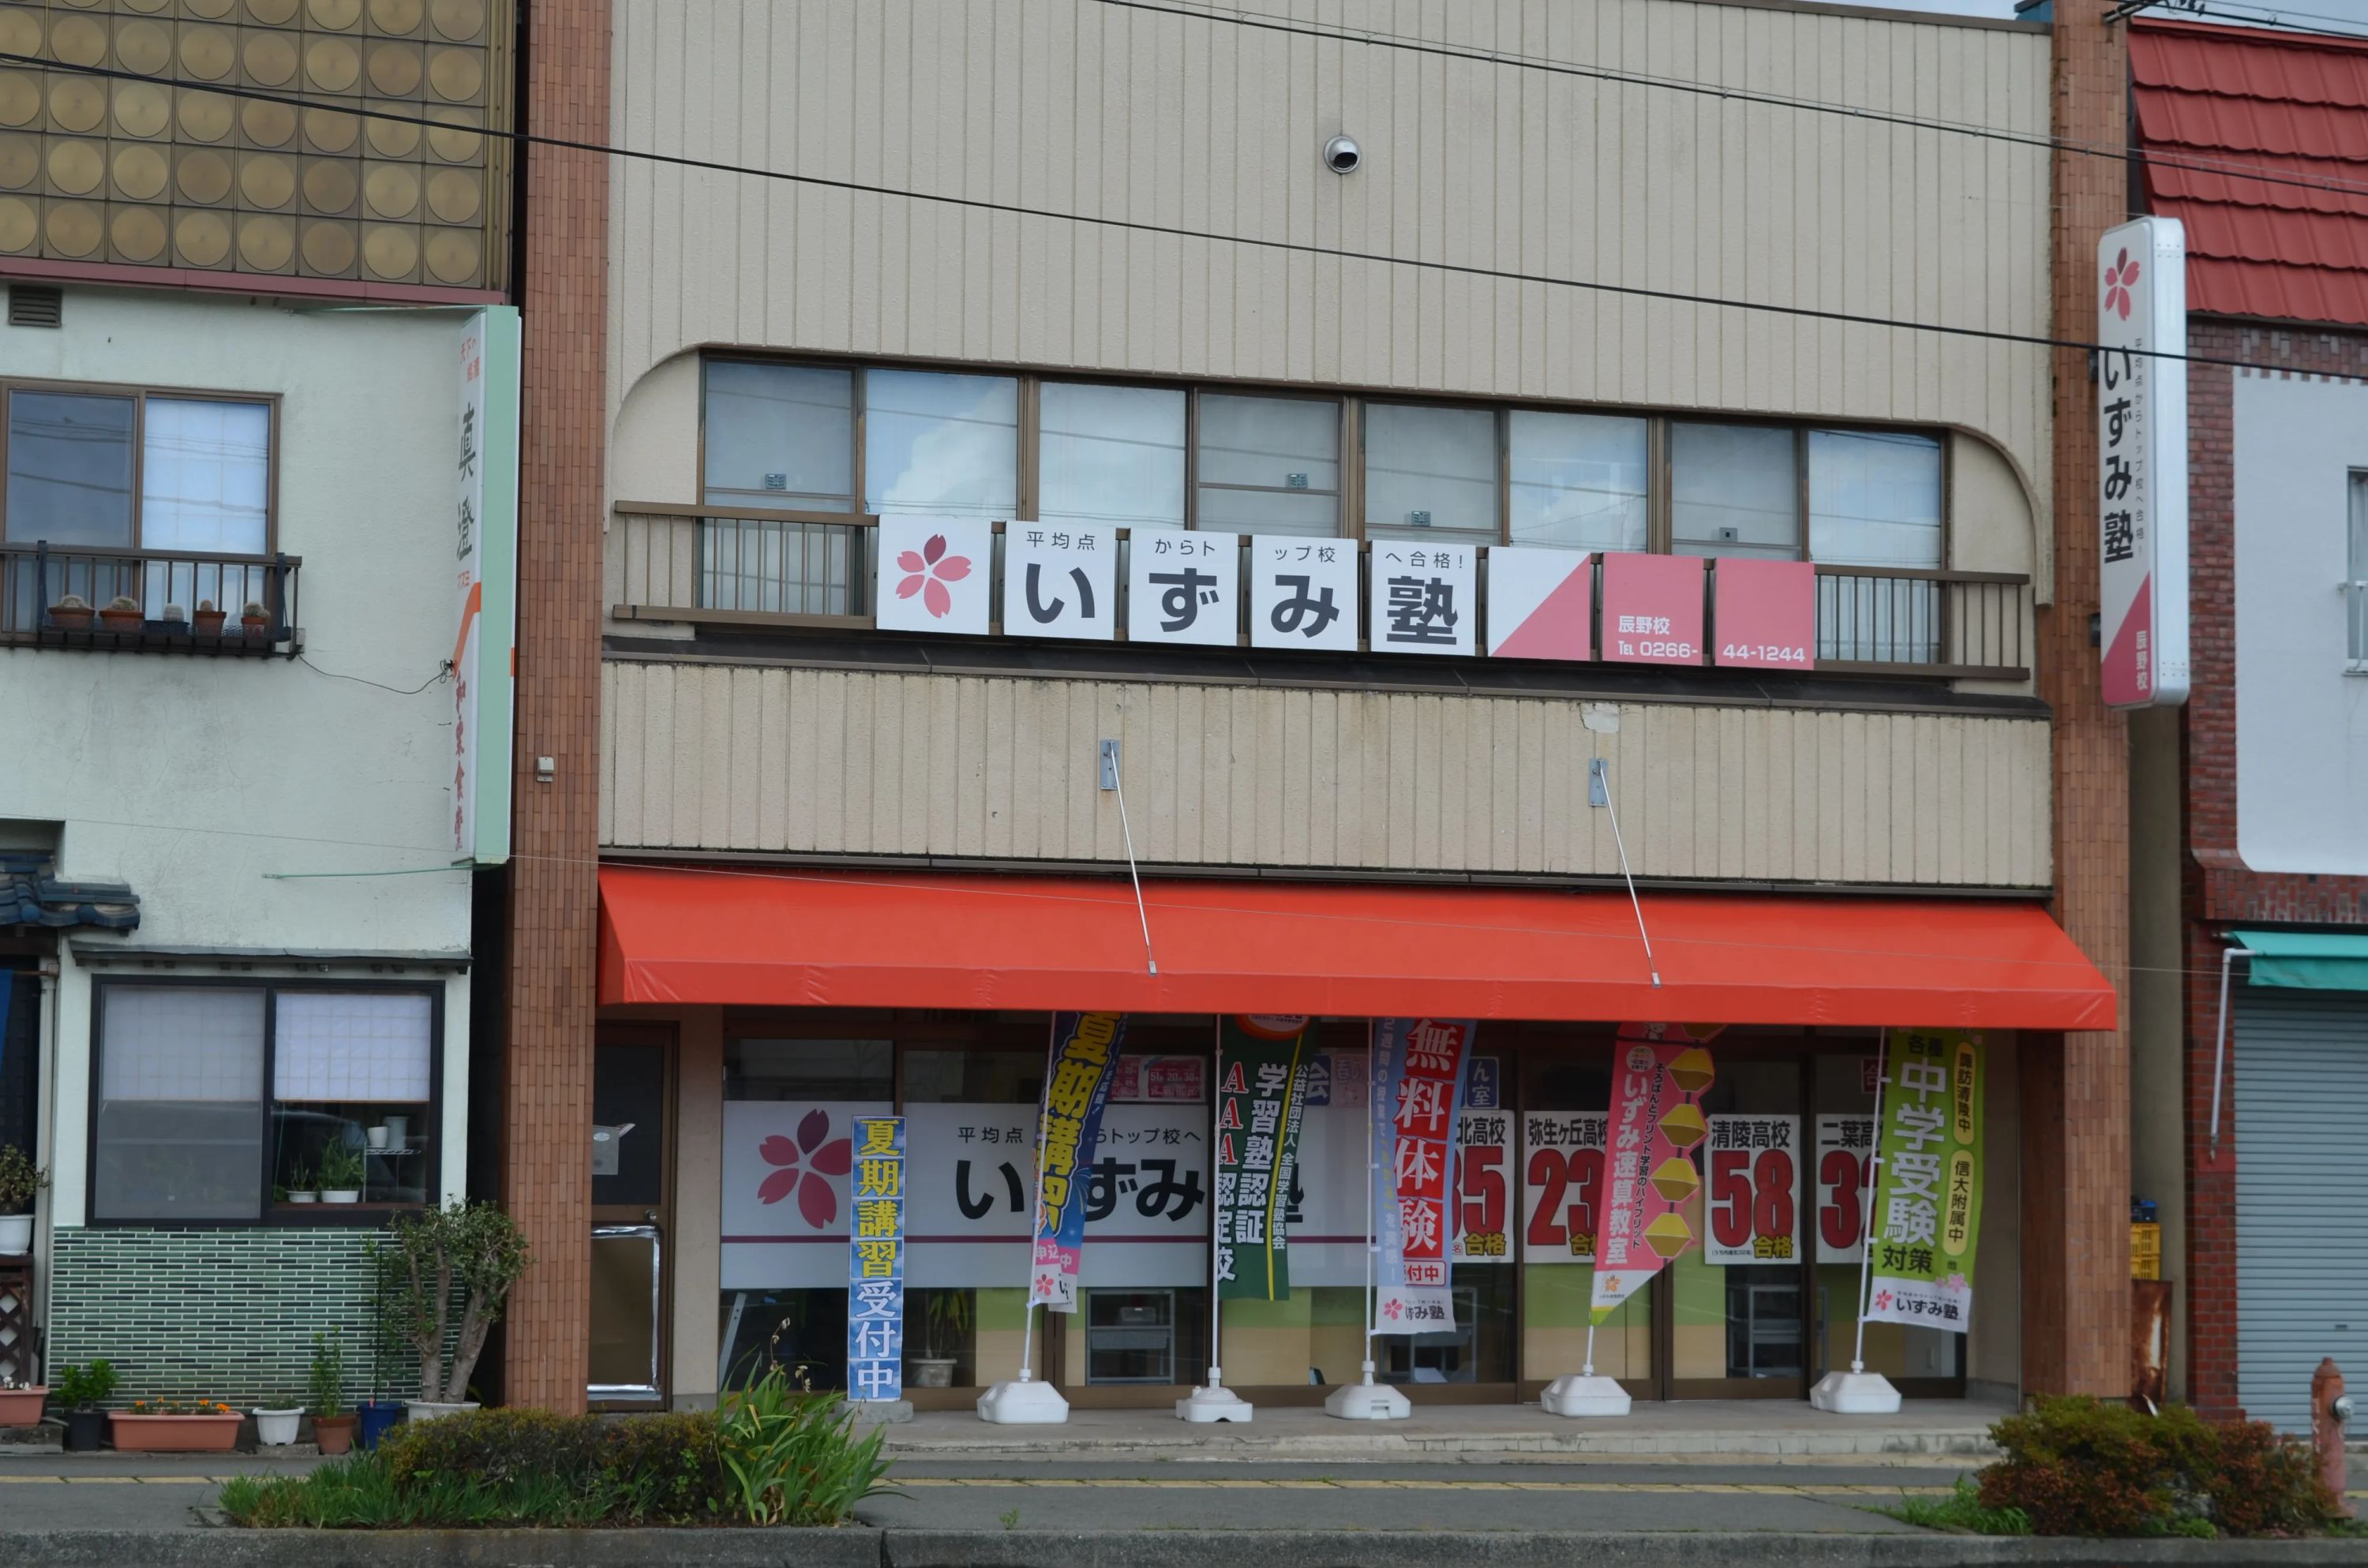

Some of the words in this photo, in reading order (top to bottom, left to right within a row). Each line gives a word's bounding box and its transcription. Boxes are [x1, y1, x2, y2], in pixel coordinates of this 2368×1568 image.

[2103, 344, 2134, 564] いずみ塾
[1025, 562, 1459, 646] いずみ塾
[1619, 615, 1671, 635] 辰野校
[2136, 630, 2149, 691] 辰野校
[1908, 1035, 1944, 1057] 各種
[1283, 1064, 1309, 1148] 公益社団法人
[1393, 1018, 1458, 1253] 無料体験
[1711, 1120, 1791, 1149] 清陵高校
[1235, 1061, 1288, 1245] 学習塾認証
[1605, 1074, 1648, 1265] いずみ速算教室
[1883, 1056, 1946, 1248] 中学受験
[1272, 1152, 1295, 1251] 全国学習塾協会
[1711, 1150, 1793, 1248] 58
[1948, 1161, 1970, 1243] 信大附属中
[853, 1118, 901, 1400] 夏期講習受付中
[1403, 1264, 1439, 1282] 付中
[1753, 1235, 1794, 1259] 合格
[1882, 1246, 1932, 1274] 対策
[1896, 1298, 1958, 1320] いずみ塾
